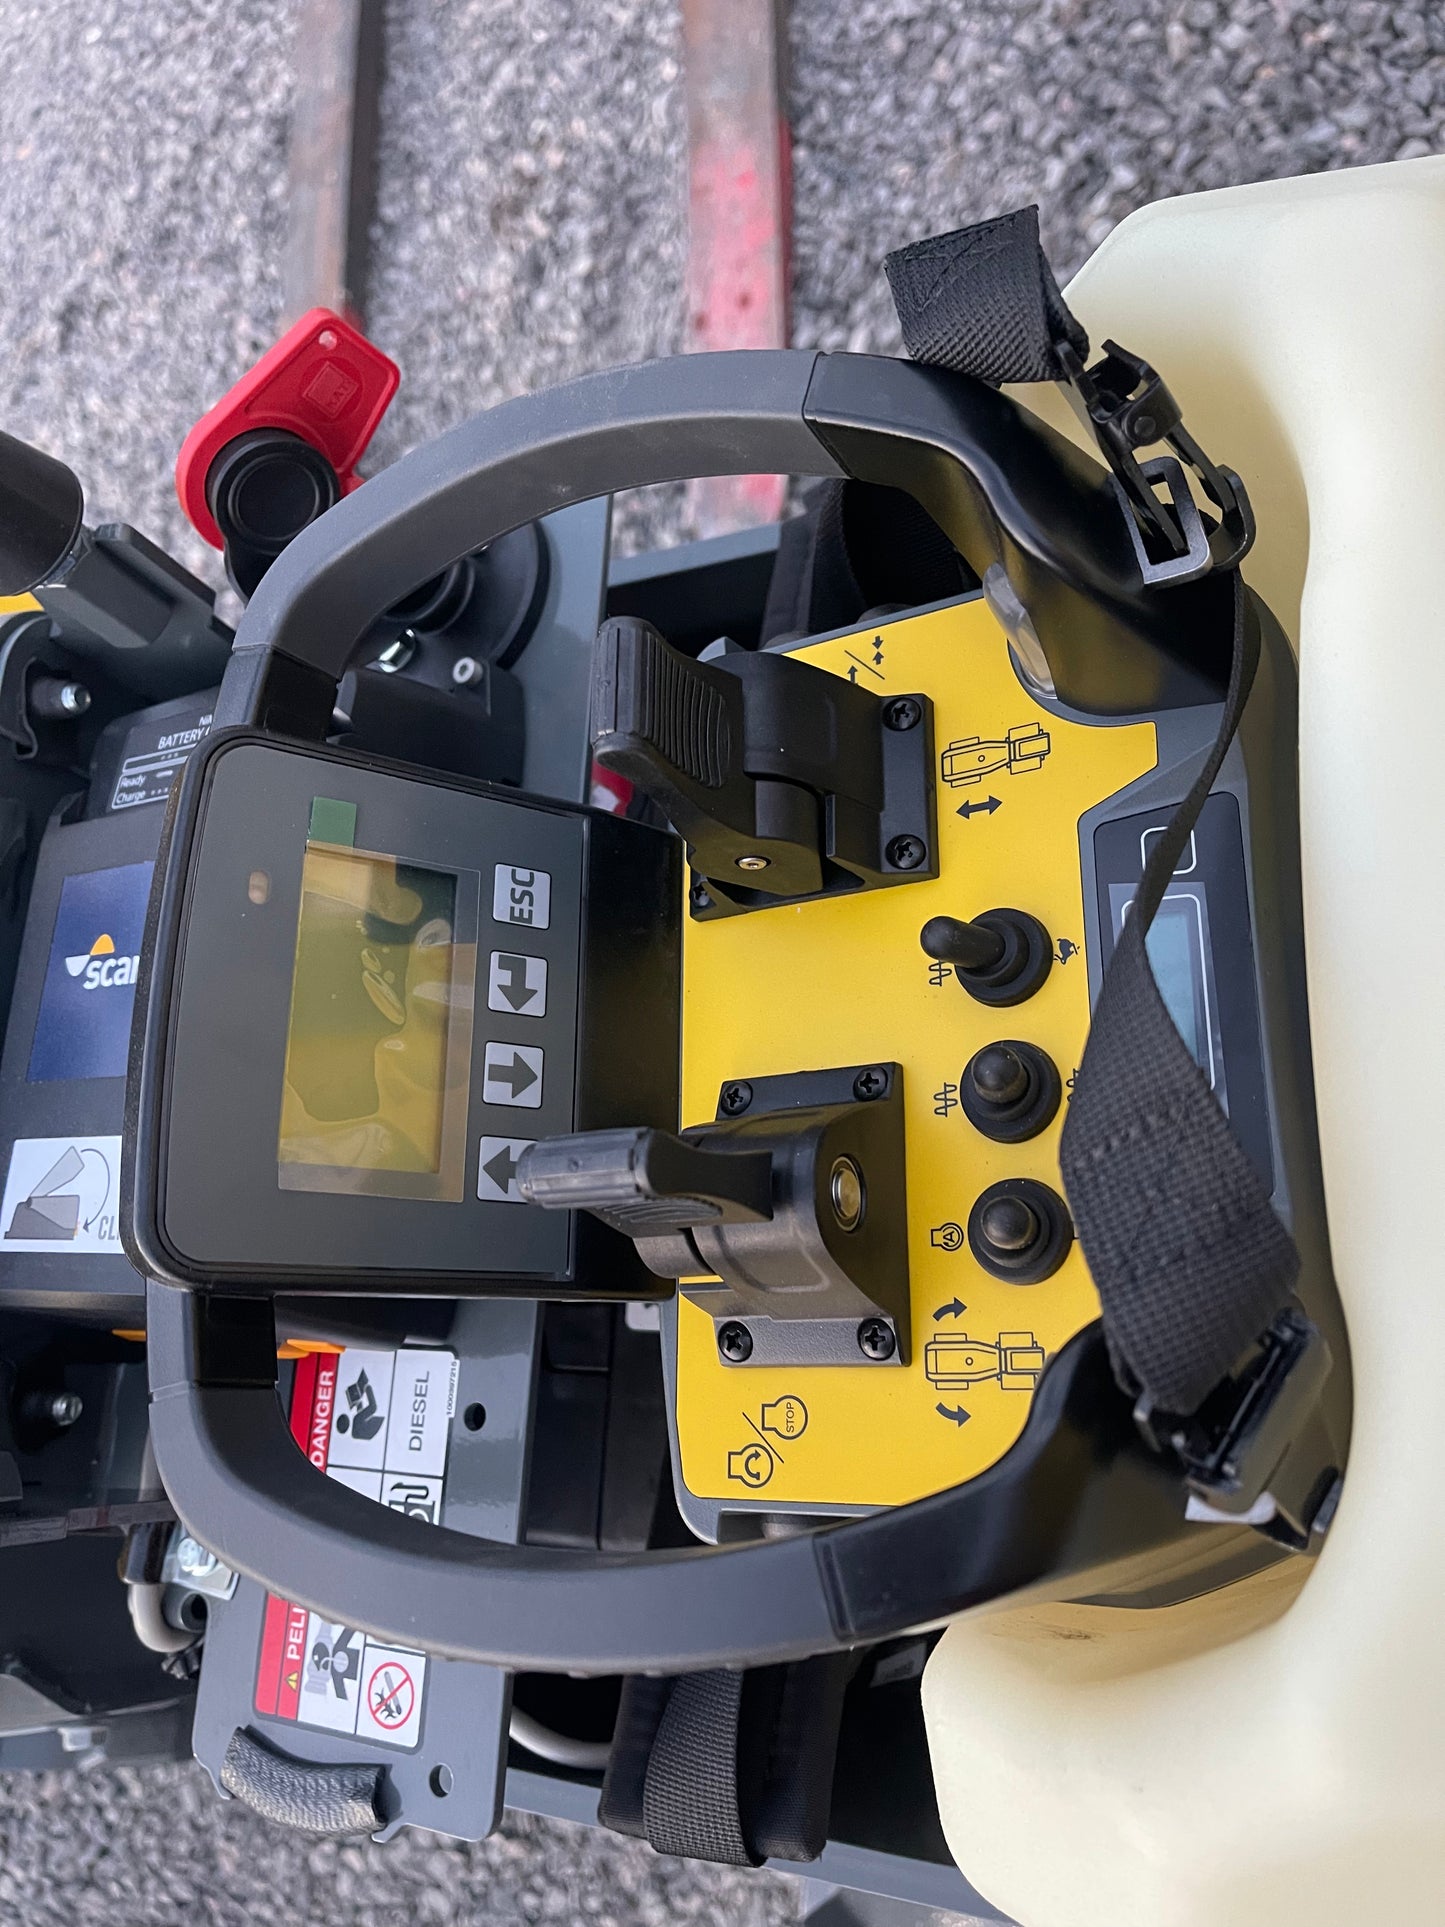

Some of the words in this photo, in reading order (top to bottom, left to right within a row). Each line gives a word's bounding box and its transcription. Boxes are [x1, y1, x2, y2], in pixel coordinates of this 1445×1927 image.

[158, 727, 204, 750] BATTERY
[120, 774, 146, 788] Ready
[116, 790, 146, 804] Charge
[509, 868, 535, 925] ESC
[98, 1215, 119, 1241] CL
[309, 1370, 334, 1467] DANGER
[408, 1371, 431, 1452] DIESEL
[786, 1402, 795, 1433] STOP
[287, 1605, 306, 1660] PELI
